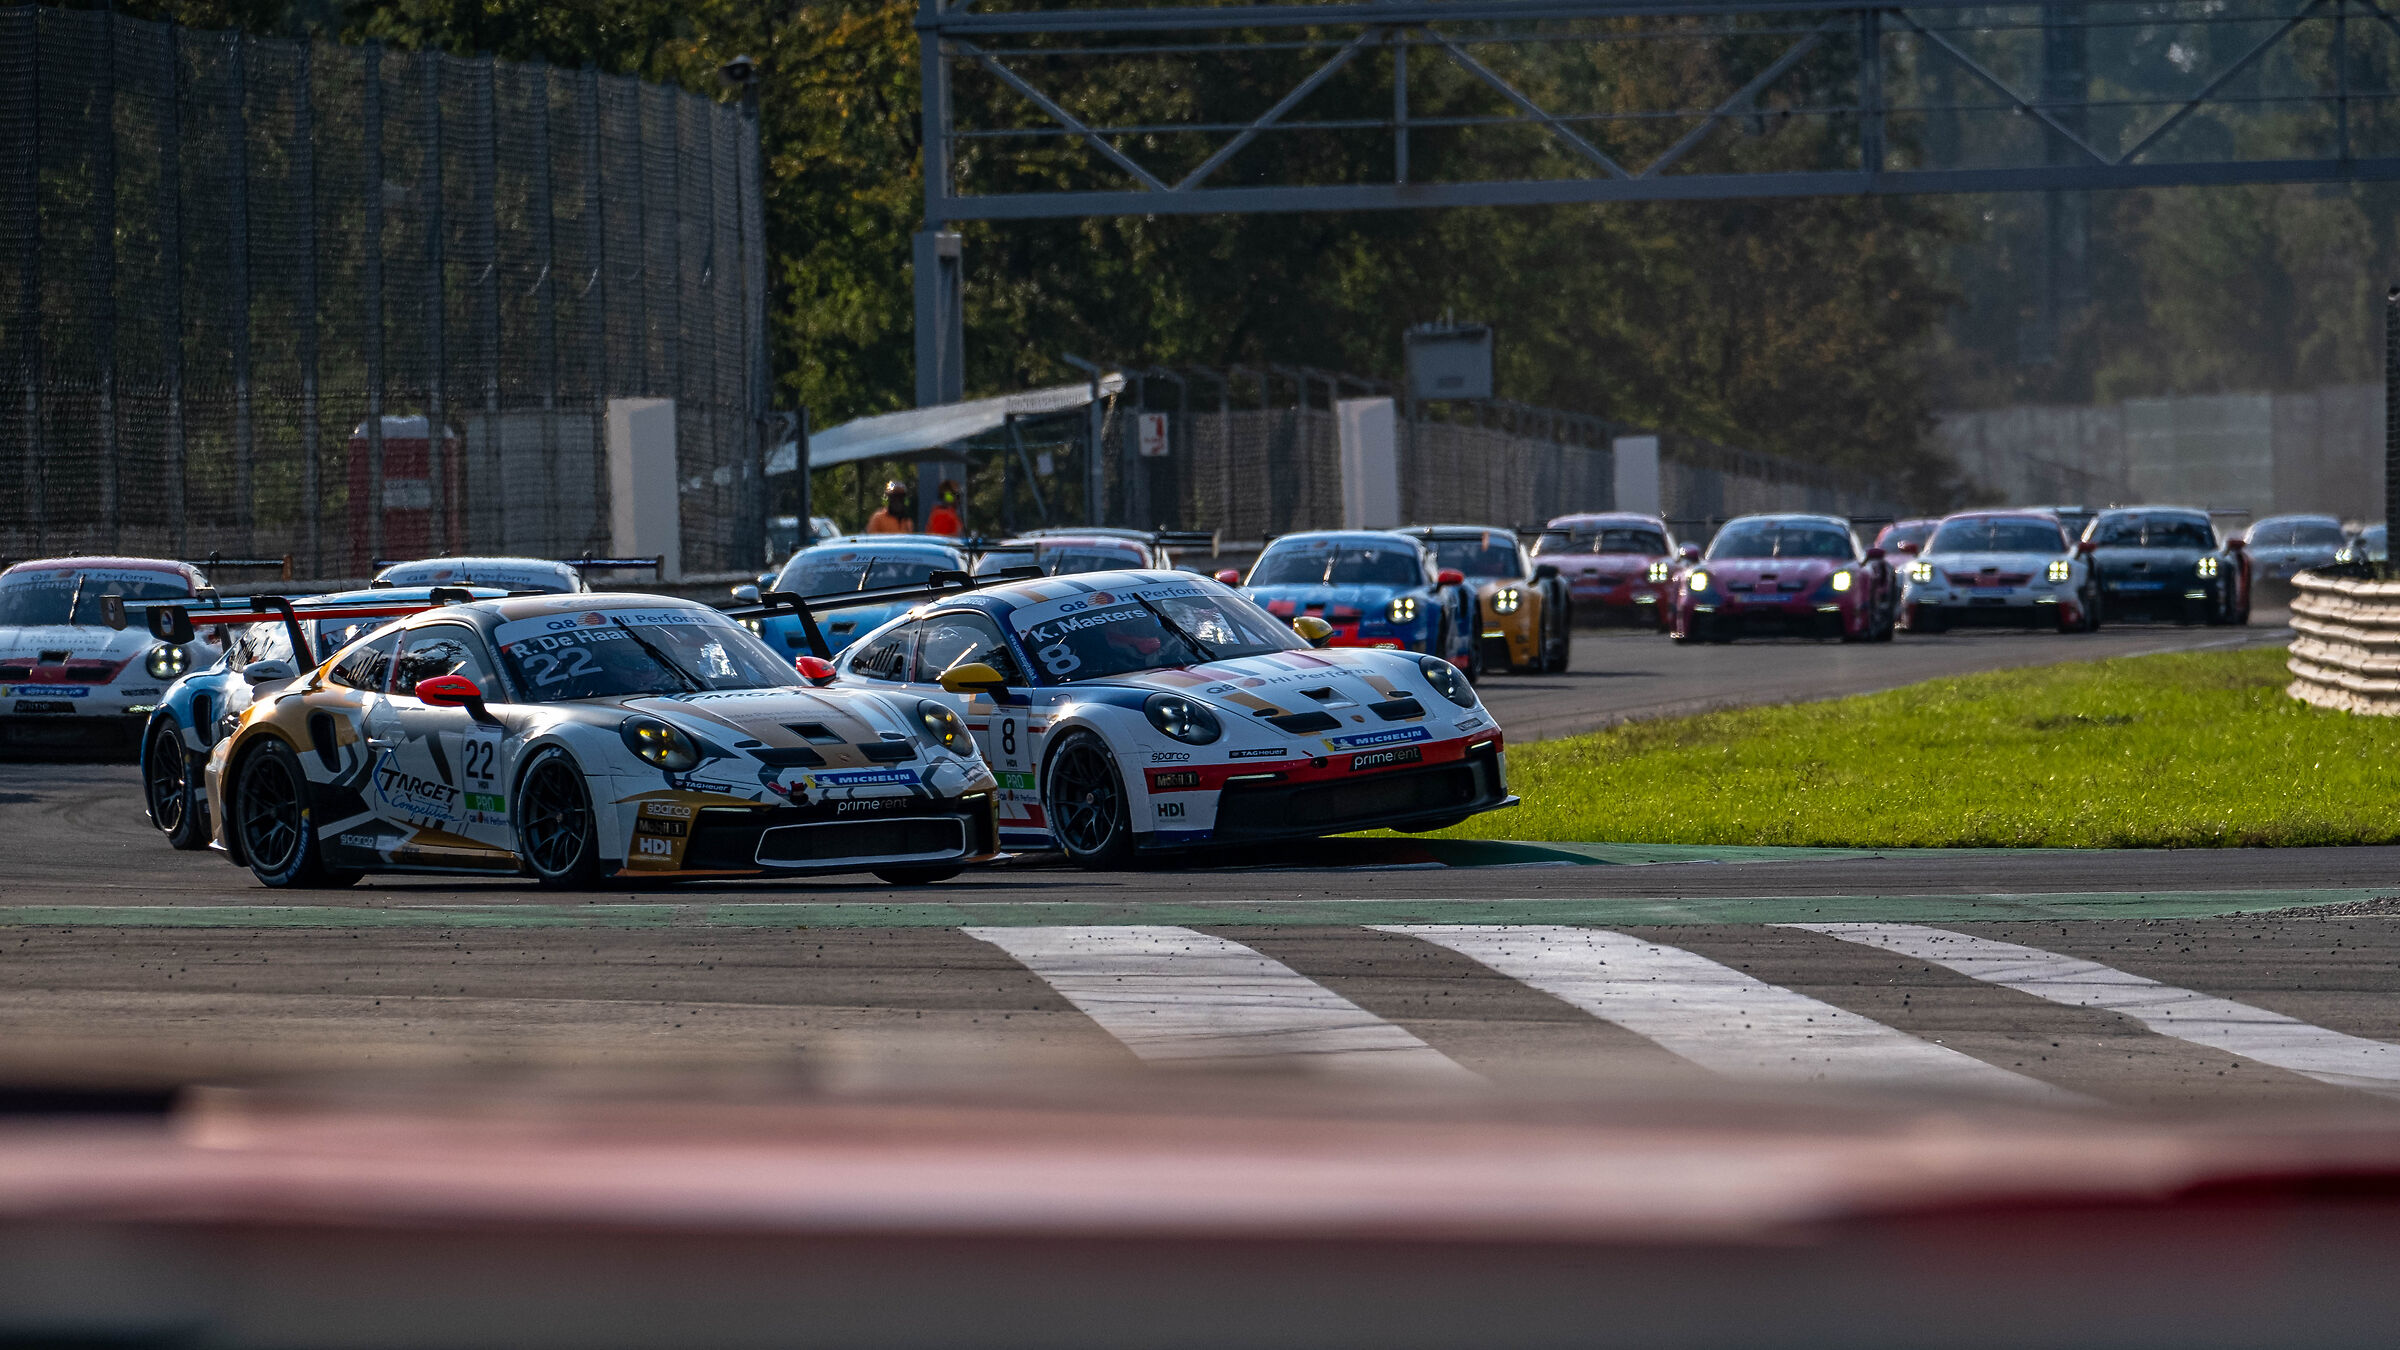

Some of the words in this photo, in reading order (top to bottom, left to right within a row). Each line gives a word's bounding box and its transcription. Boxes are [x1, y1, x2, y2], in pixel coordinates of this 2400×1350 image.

[1059, 600, 1088, 612] Q8
[1141, 587, 1209, 599] Perform
[546, 619, 577, 630] Q8
[635, 613, 707, 625] Perform
[1058, 607, 1149, 635] Masters
[510, 643, 539, 659] R.
[537, 636, 575, 651] De
[523, 647, 604, 687] 22
[1038, 643, 1081, 675] 8
[1206, 684, 1237, 694] Q8
[1294, 668, 1375, 681] Perform
[1002, 717, 1016, 755] 8
[1355, 730, 1422, 745] MICHELIN
[465, 739, 494, 780] 22
[1151, 752, 1190, 763] sparco
[1354, 748, 1419, 770] primerent
[380, 767, 460, 803] TARGET
[838, 773, 911, 784] MICHELIN
[1006, 774, 1024, 789] PRO
[391, 795, 462, 822] Competition
[476, 795, 495, 811] PRO
[646, 803, 691, 818] sparco
[837, 798, 909, 815] primerent
[1157, 802, 1185, 817] HDI
[639, 820, 670, 834] Mobil
[339, 833, 374, 847] sparco
[639, 837, 672, 855] HDI
